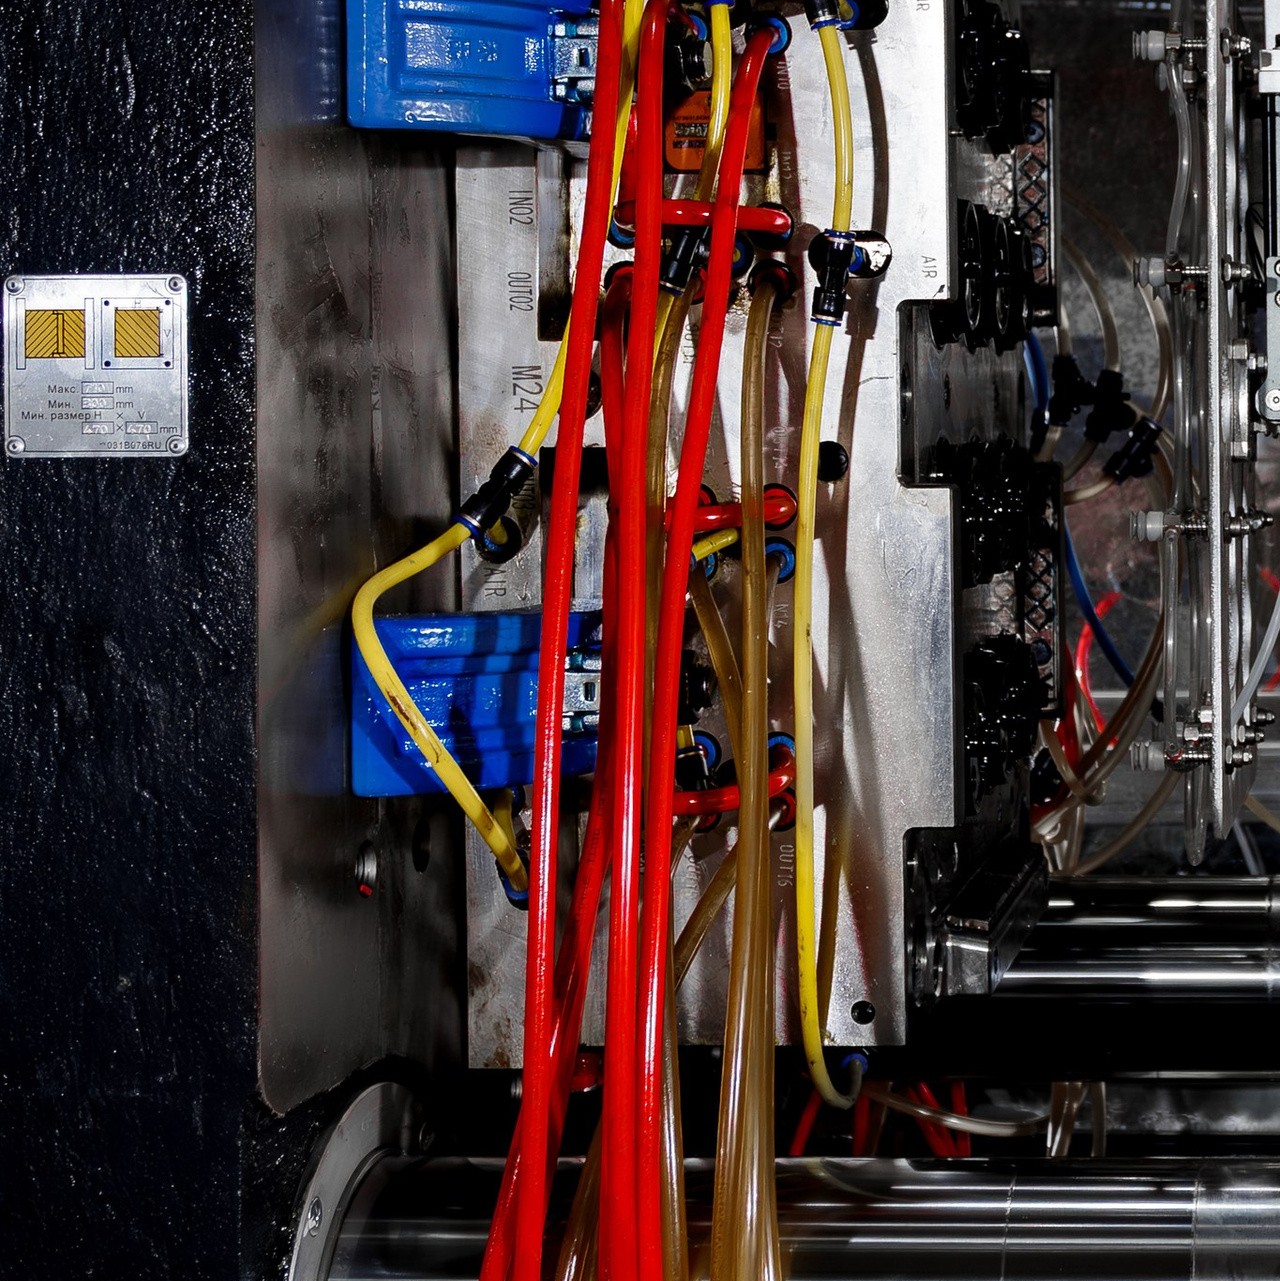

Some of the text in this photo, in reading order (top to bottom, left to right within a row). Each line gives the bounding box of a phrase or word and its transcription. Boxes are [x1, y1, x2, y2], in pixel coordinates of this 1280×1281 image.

[508, 190, 534, 225] IN02
[921, 255, 938, 279] AIR
[163, 329, 171, 338] V
[48, 384, 79, 394] Макс.
[115, 386, 133, 394] mm
[512, 365, 543, 413] M24
[48, 399, 74, 409] Мин.
[115, 401, 133, 409] mm
[21, 411, 48, 420] Мин.
[50, 411, 91, 423] размер
[159, 426, 178, 434] mm
[483, 567, 507, 598] AIR
